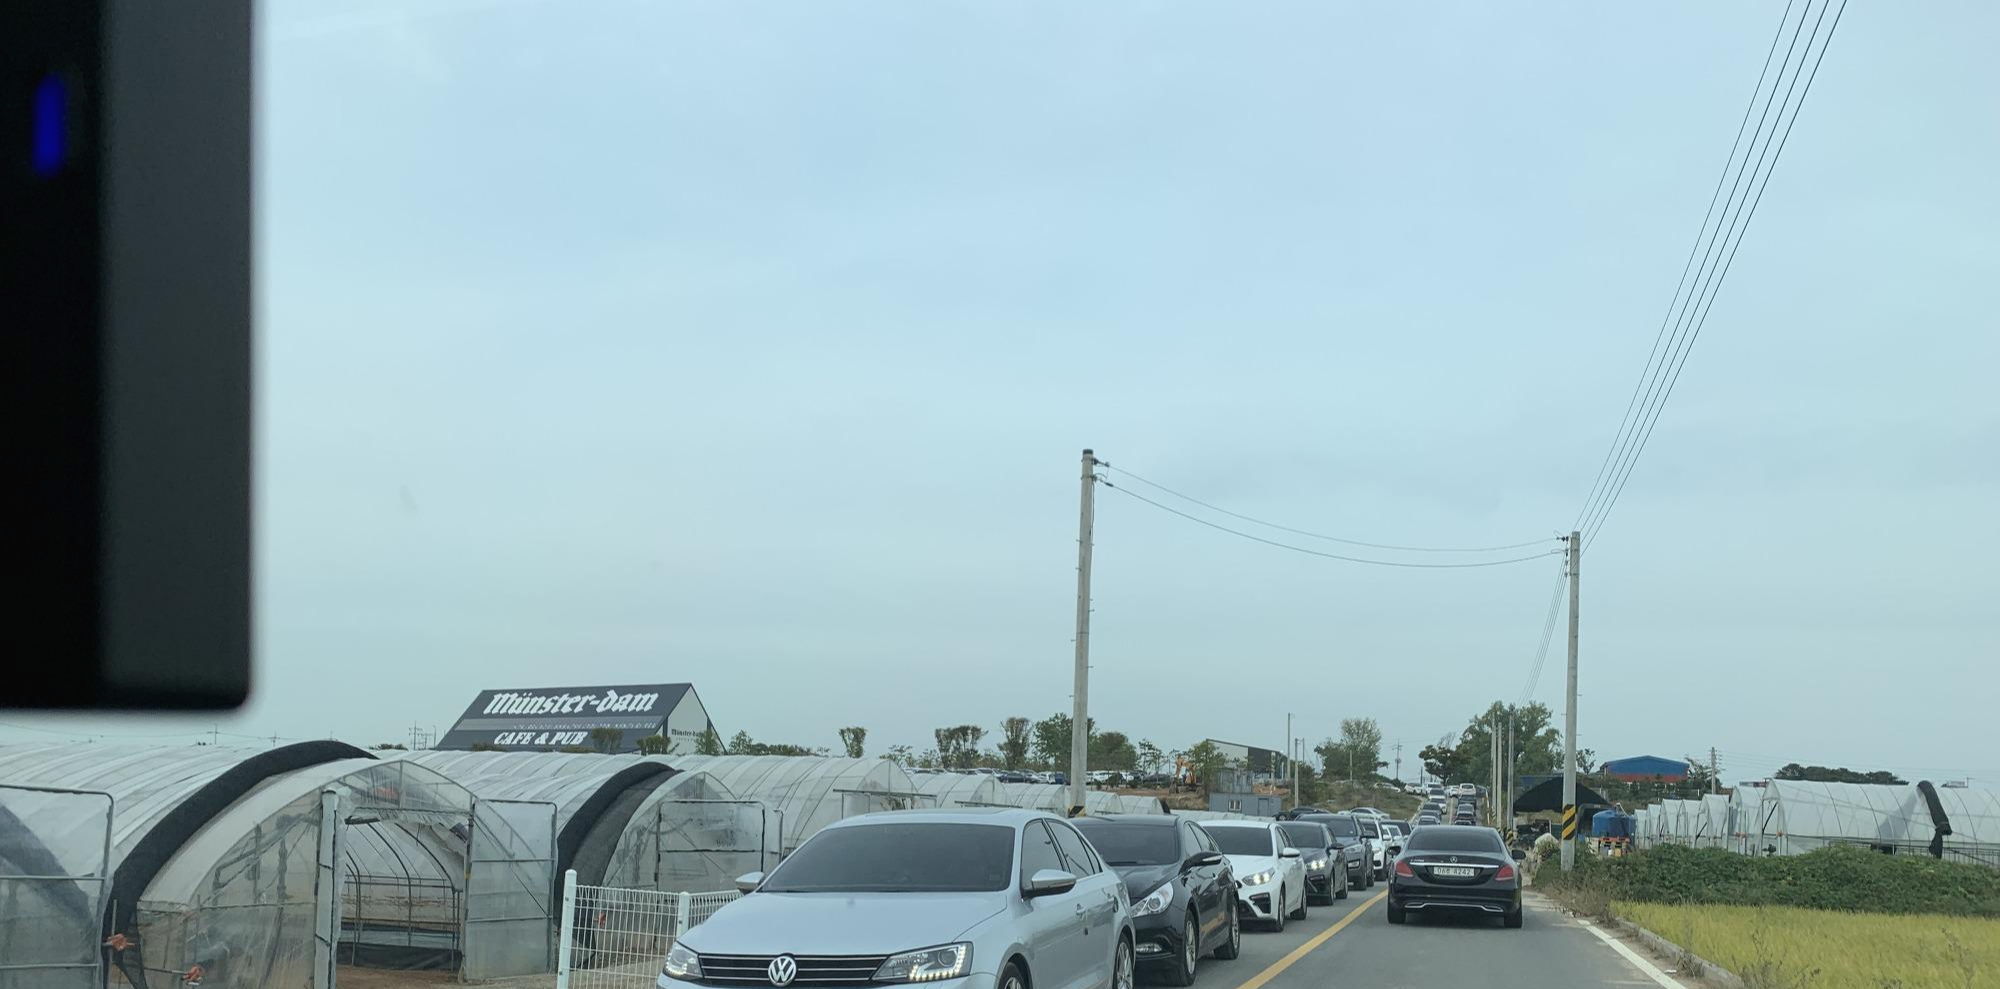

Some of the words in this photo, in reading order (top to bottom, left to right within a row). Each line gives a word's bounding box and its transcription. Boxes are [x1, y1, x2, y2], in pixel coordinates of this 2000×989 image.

[483, 689, 659, 715] Münster-dam
[493, 731, 536, 745] CAFE
[534, 731, 550, 745] &
[548, 731, 589, 745] PUB
